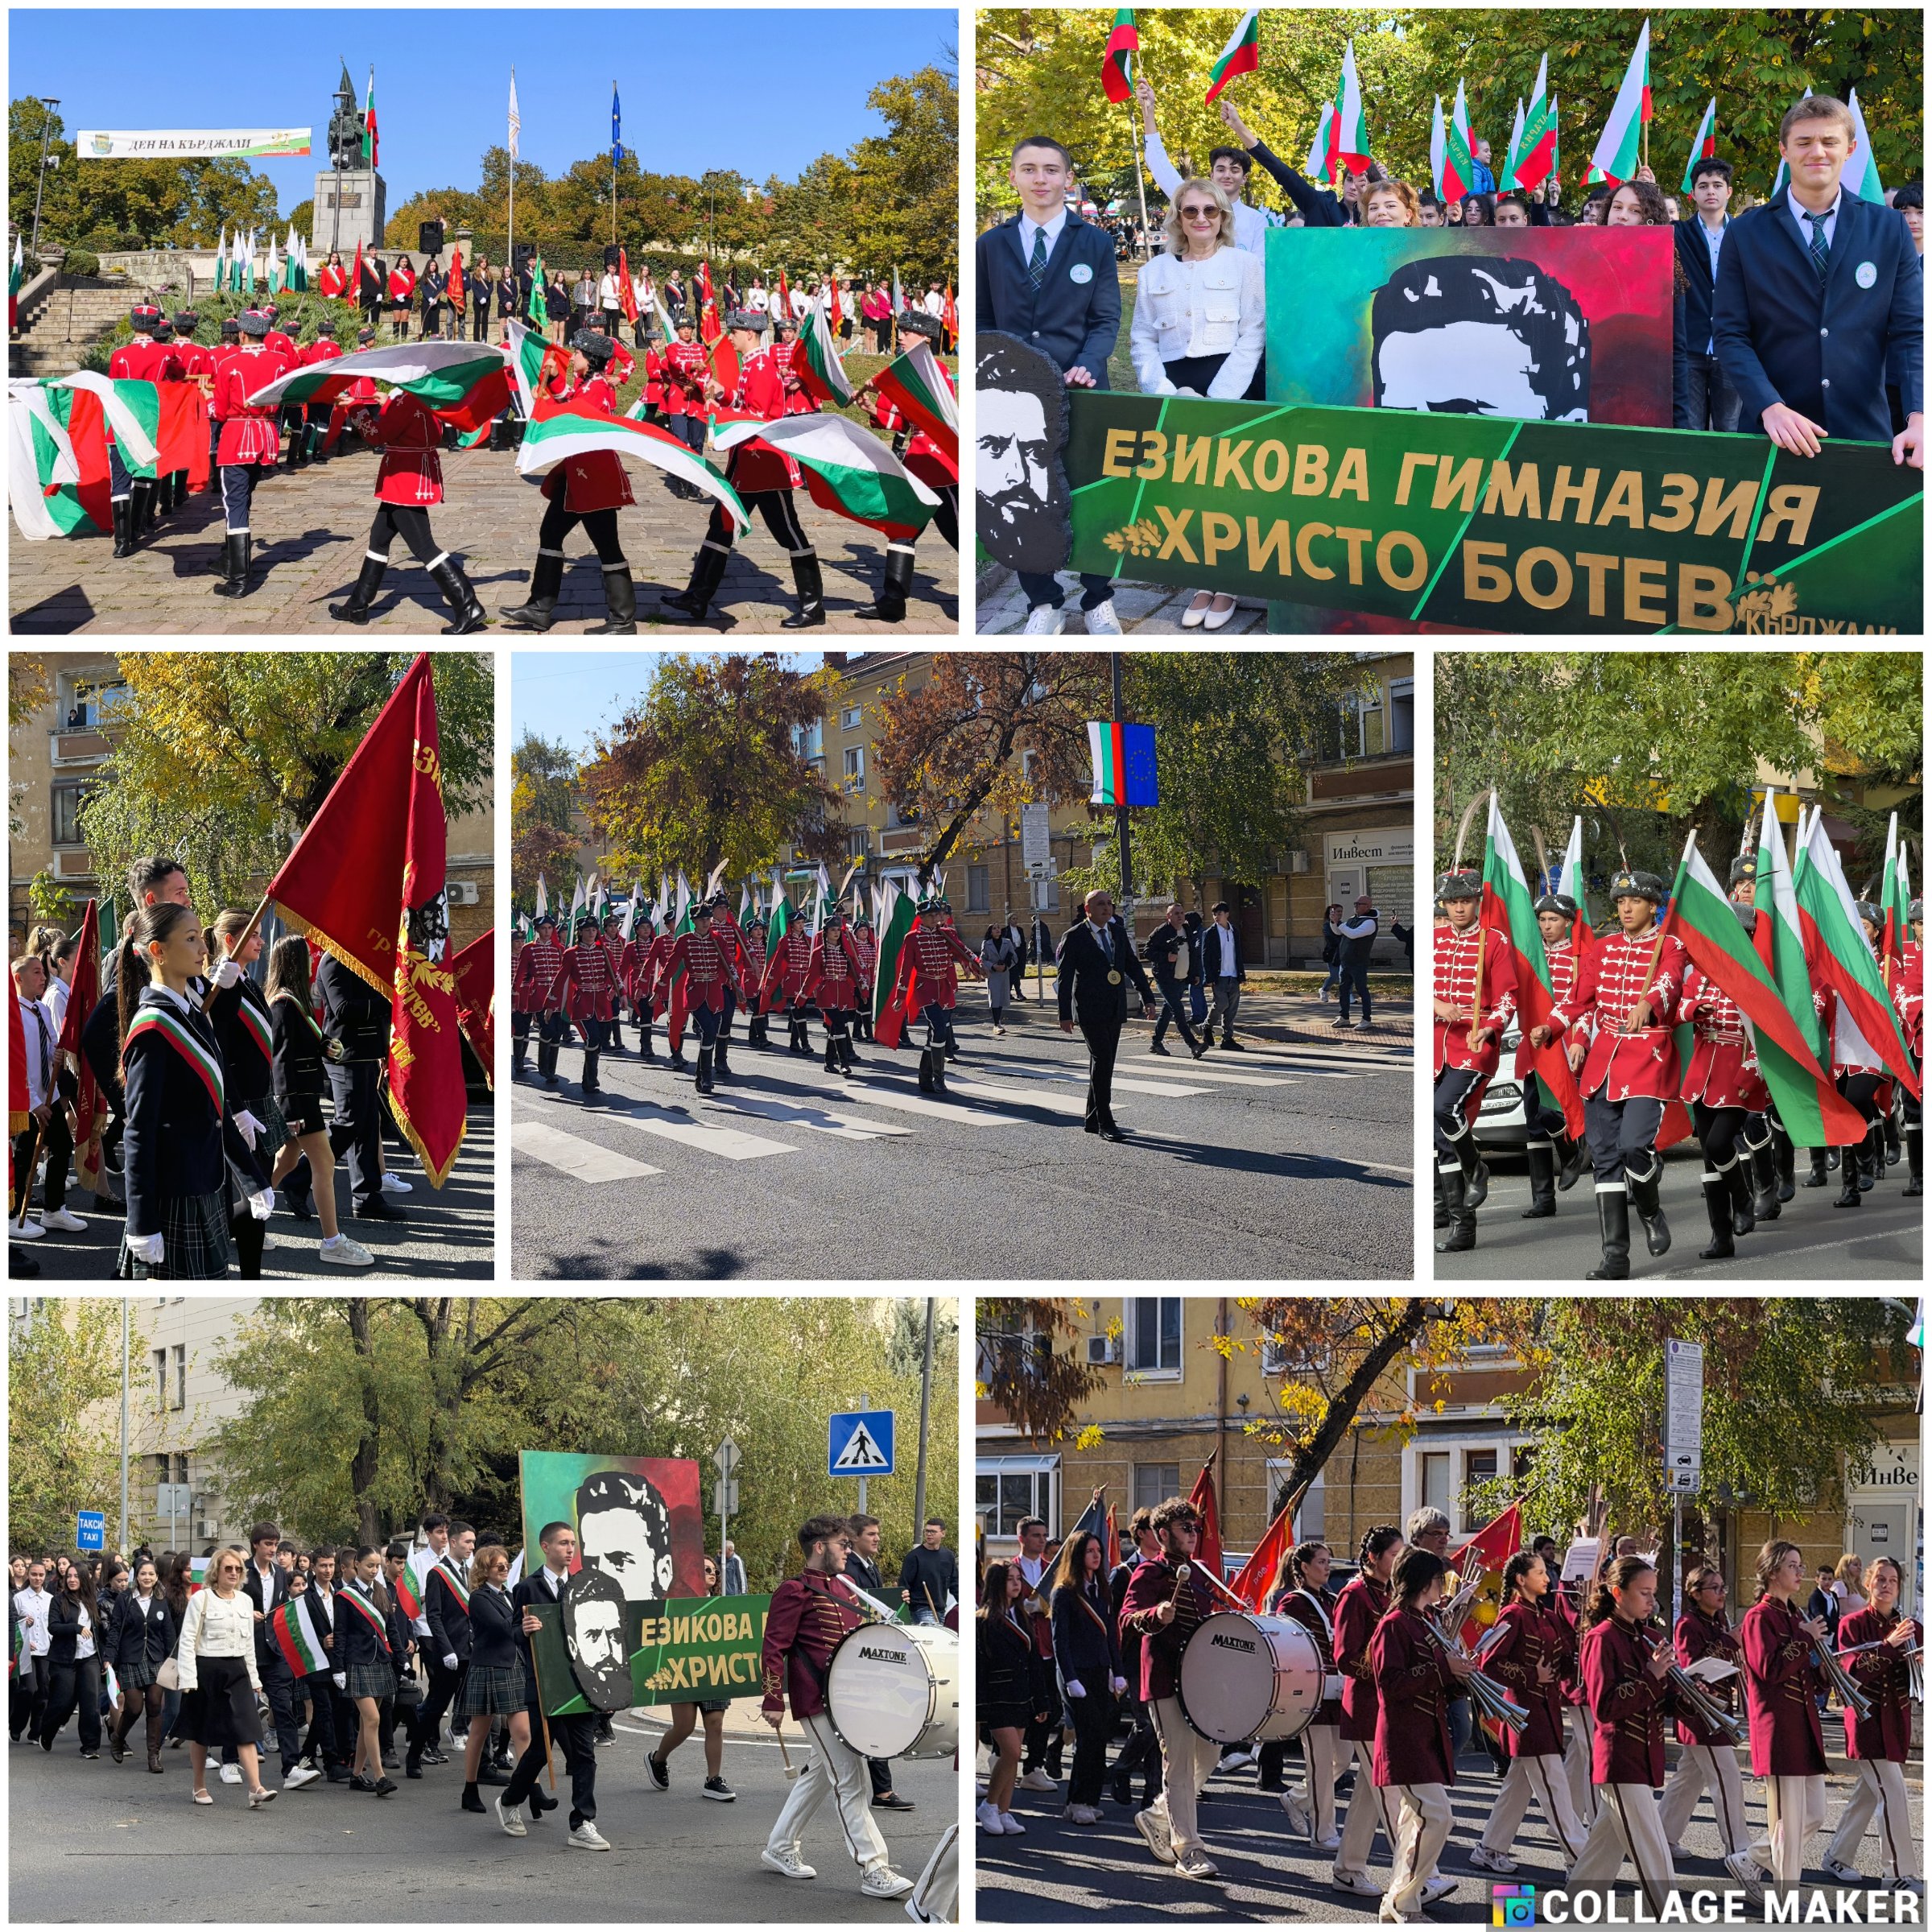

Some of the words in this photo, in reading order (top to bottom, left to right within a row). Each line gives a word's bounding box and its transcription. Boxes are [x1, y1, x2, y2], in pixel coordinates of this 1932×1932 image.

[129, 140, 155, 151] ДЕН
[159, 139, 175, 150] НА
[178, 138, 251, 151] КЪРДЖАЛИ
[1102, 428, 1369, 502] ЕЗИКОВА
[1394, 452, 1821, 546] ГИМНАЗИЯ
[1154, 506, 1428, 592] ХРИСТО
[1463, 539, 1735, 632] БОТЕВ
[1859, 1466, 1919, 1485] Инве
[79, 1518, 103, 1530] ТАКСИ
[83, 1532, 98, 1542] TAXI
[641, 1612, 754, 1647] ЕЗИКОВА
[1210, 1633, 1257, 1652] MAXTONE
[858, 1646, 907, 1662] MAXTONE
[667, 1652, 762, 1690] ХРИСТ
